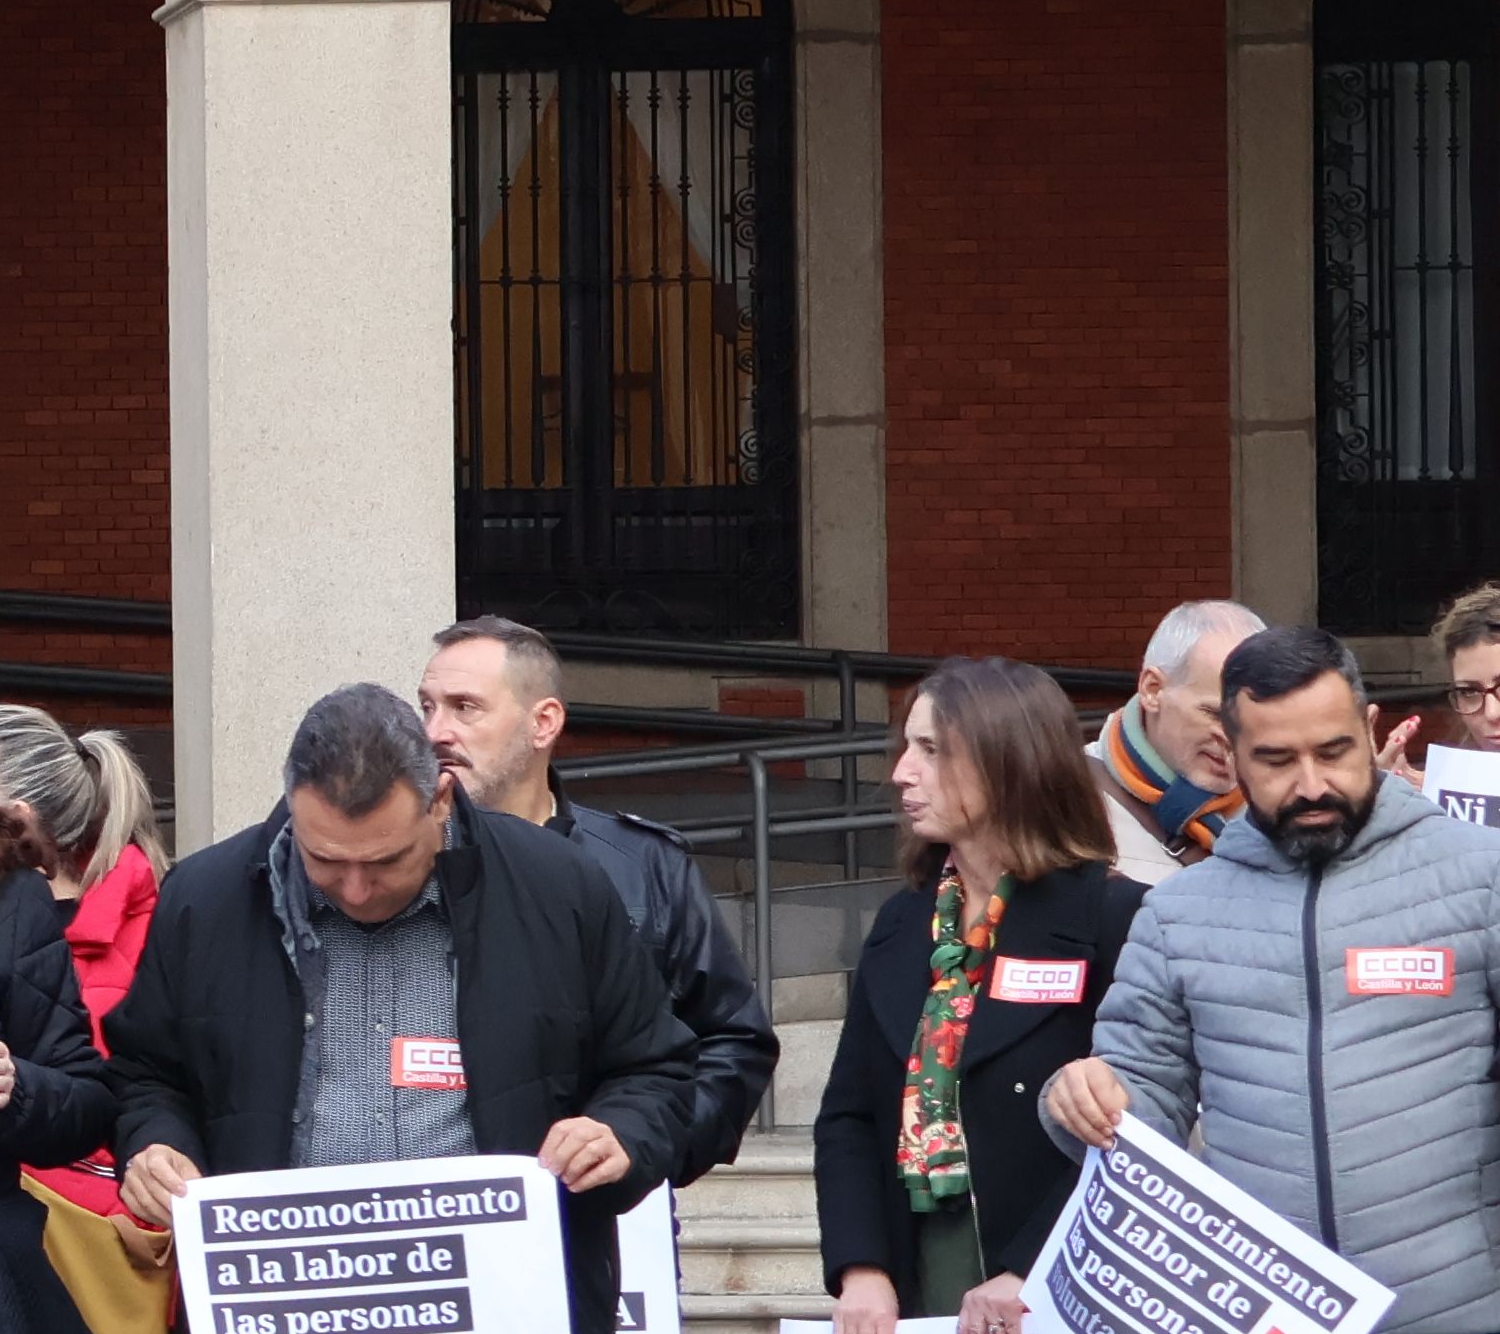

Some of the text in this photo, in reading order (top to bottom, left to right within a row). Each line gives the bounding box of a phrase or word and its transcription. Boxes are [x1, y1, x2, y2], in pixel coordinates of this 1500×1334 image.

[1364, 958, 1435, 972] CCOO
[1010, 969, 1071, 983] CCOO
[1358, 979, 1443, 991] Castilla y León
[1049, 989, 1074, 999] León
[411, 1049, 462, 1065] CCO
[403, 1072, 447, 1083] Castilla
[449, 1076, 457, 1086] y
[212, 1186, 521, 1234] Reconocimiento
[1091, 1185, 1114, 1225] la
[1113, 1209, 1209, 1287] labor
[1208, 1280, 1253, 1320] de
[218, 1242, 453, 1286] a la labor de
